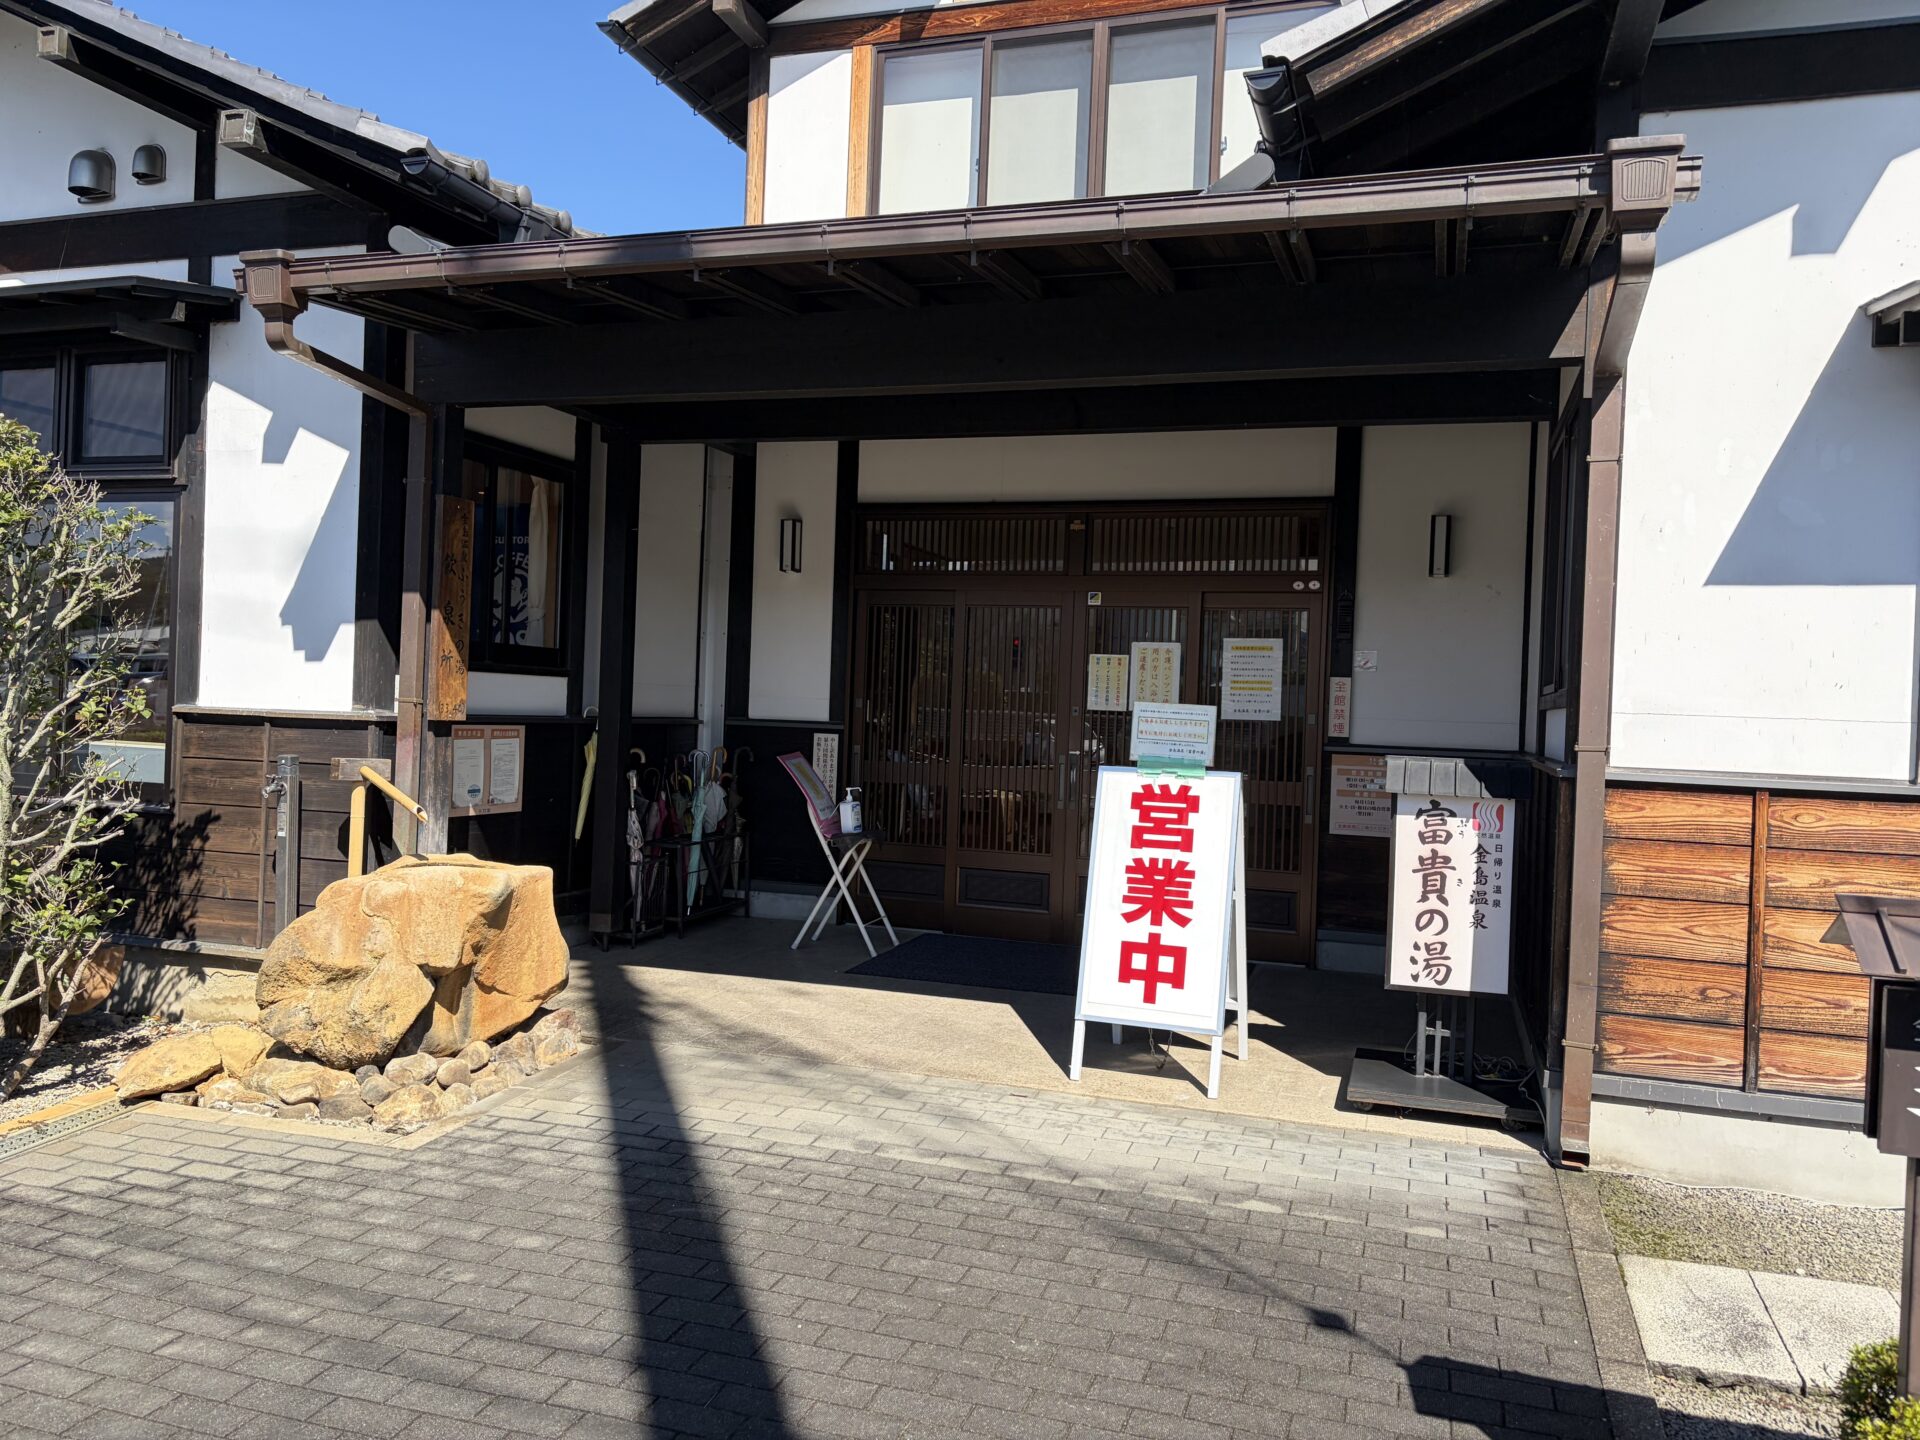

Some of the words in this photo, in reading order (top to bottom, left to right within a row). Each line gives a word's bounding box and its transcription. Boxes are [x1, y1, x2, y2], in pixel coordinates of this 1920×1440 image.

[1333, 680, 1346, 734] 全館禁煙
[1119, 784, 1200, 1004] 営業中
[1410, 799, 1458, 987] 富貴の湯
[1469, 843, 1492, 929] 金島温泉
[1492, 843, 1503, 908] 日帰り温泉
